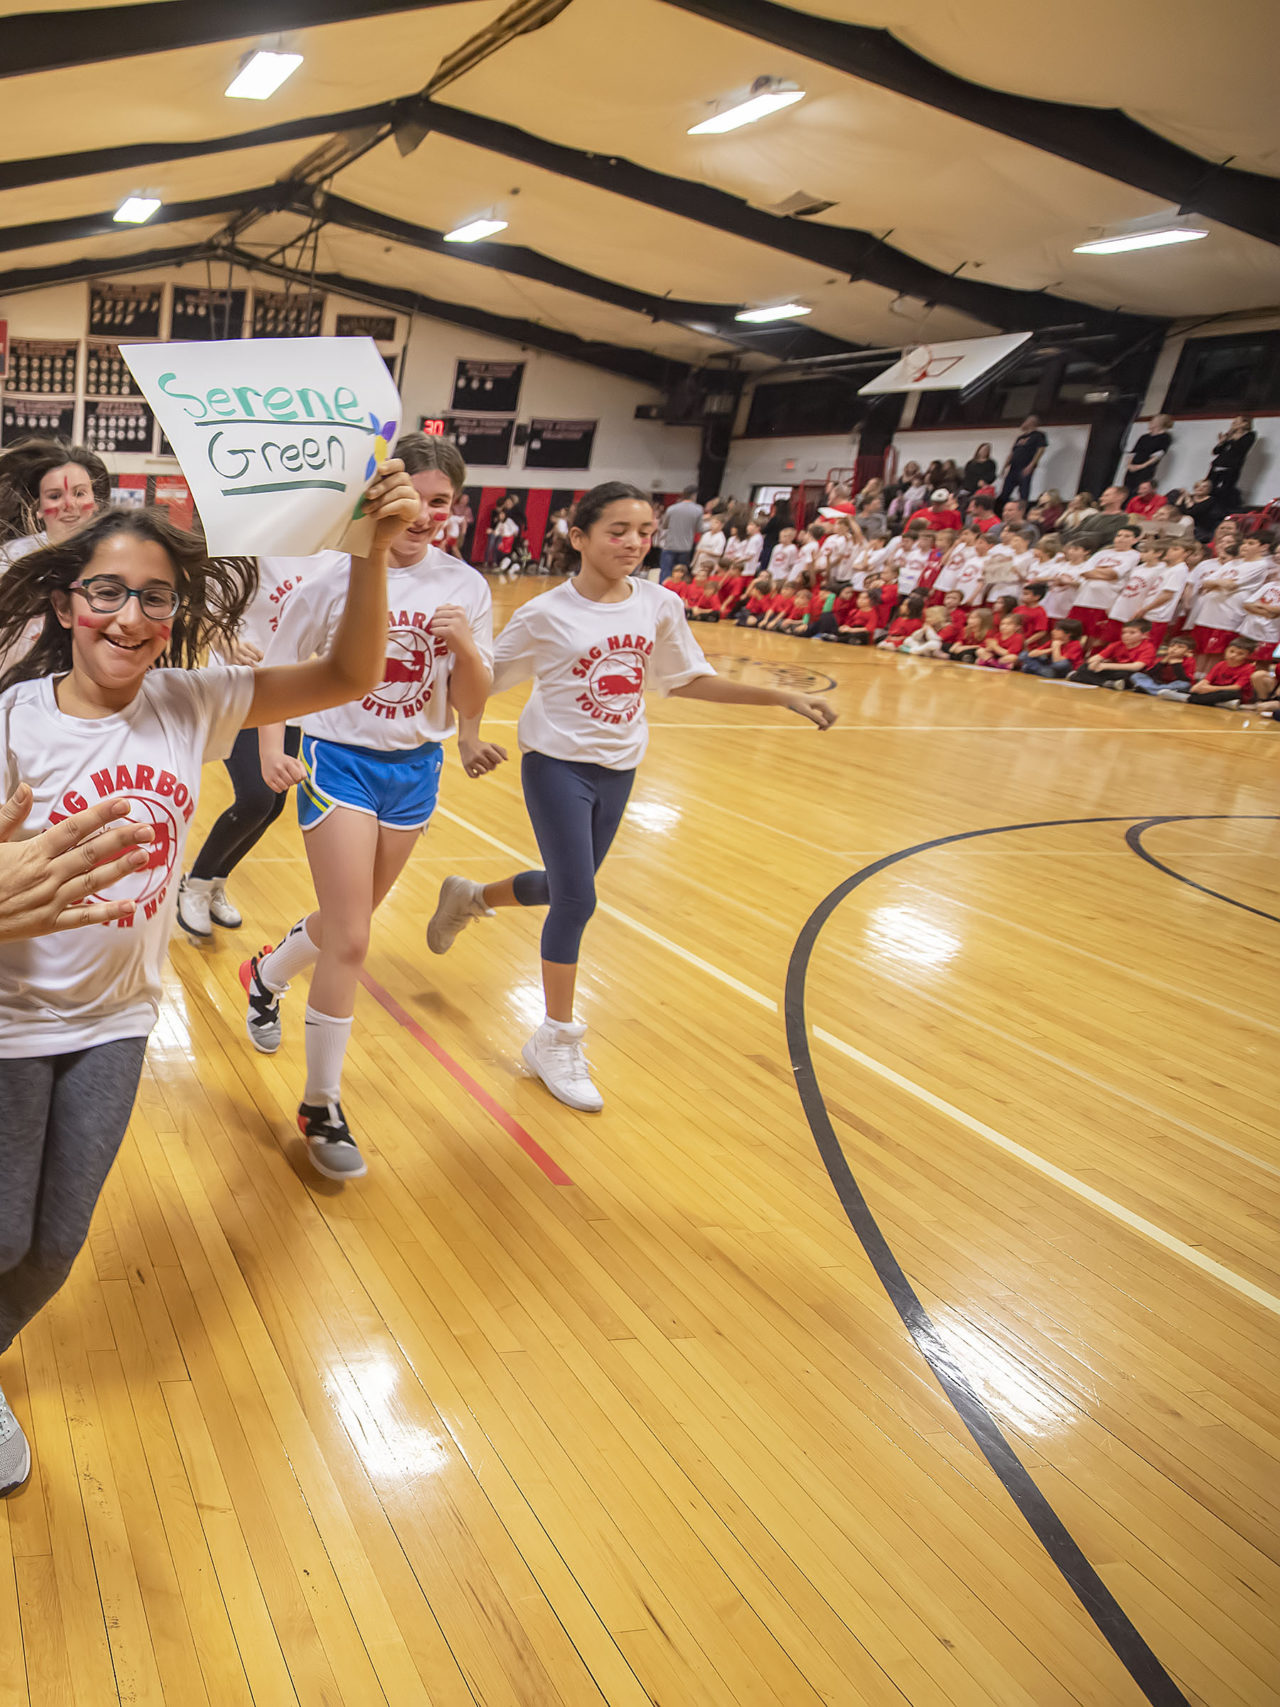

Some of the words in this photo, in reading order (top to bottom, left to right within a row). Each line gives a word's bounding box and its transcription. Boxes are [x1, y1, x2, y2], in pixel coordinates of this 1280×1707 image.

[158, 372, 364, 422] Serene
[423, 419, 445, 437] 30
[208, 431, 345, 479] Green
[269, 580, 293, 604] SAG
[572, 646, 602, 678] SAG
[575, 692, 622, 724] YOUTH
